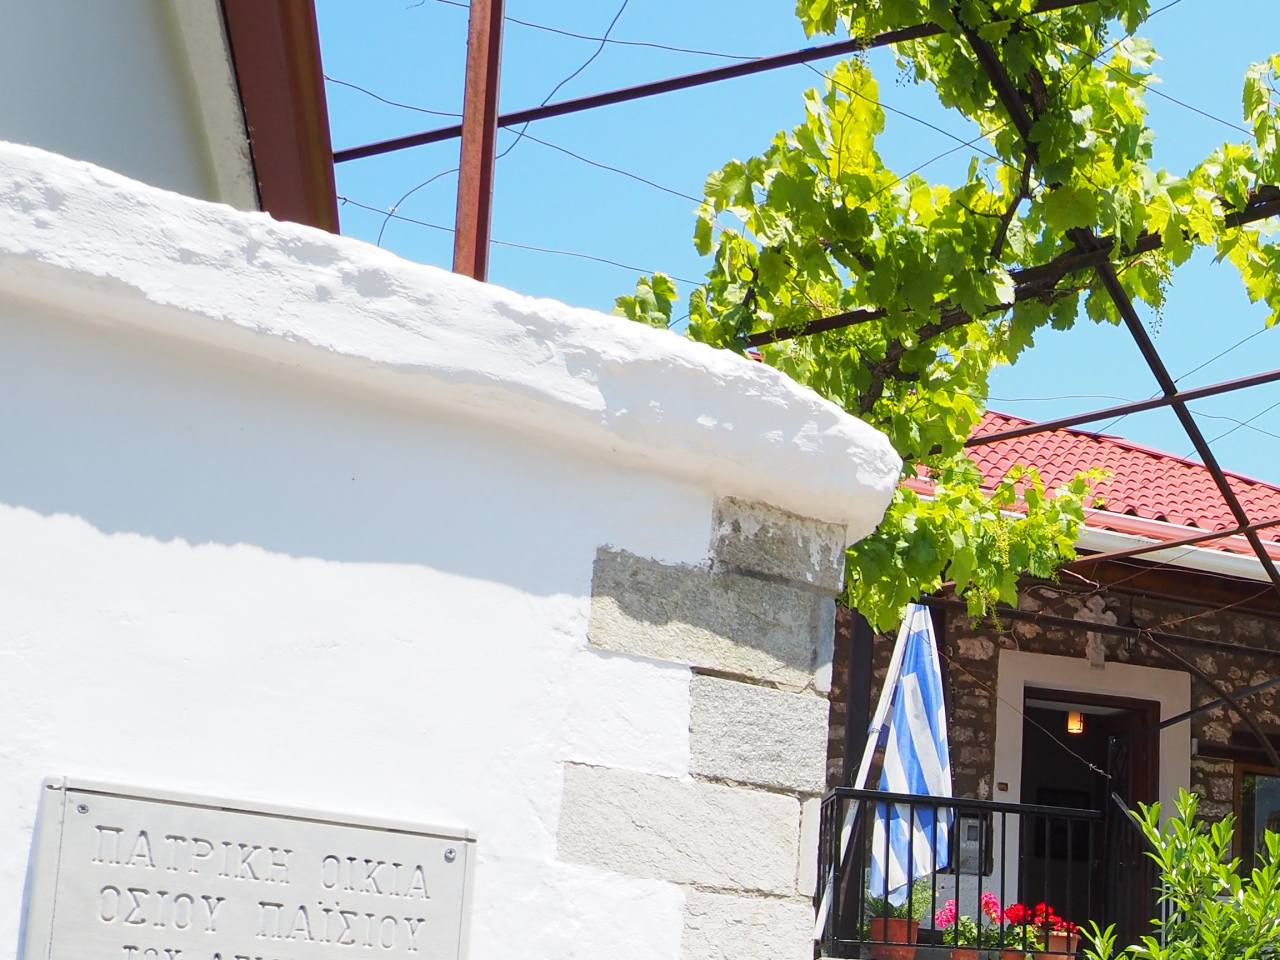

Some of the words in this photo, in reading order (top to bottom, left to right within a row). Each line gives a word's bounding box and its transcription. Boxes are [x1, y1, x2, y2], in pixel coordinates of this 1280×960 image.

[91, 825, 294, 885] ΠΑΤΡΙΚΗ
[321, 855, 432, 900] ΟΙΚΙΑ
[99, 885, 227, 933] ΟΣΙΟΥ
